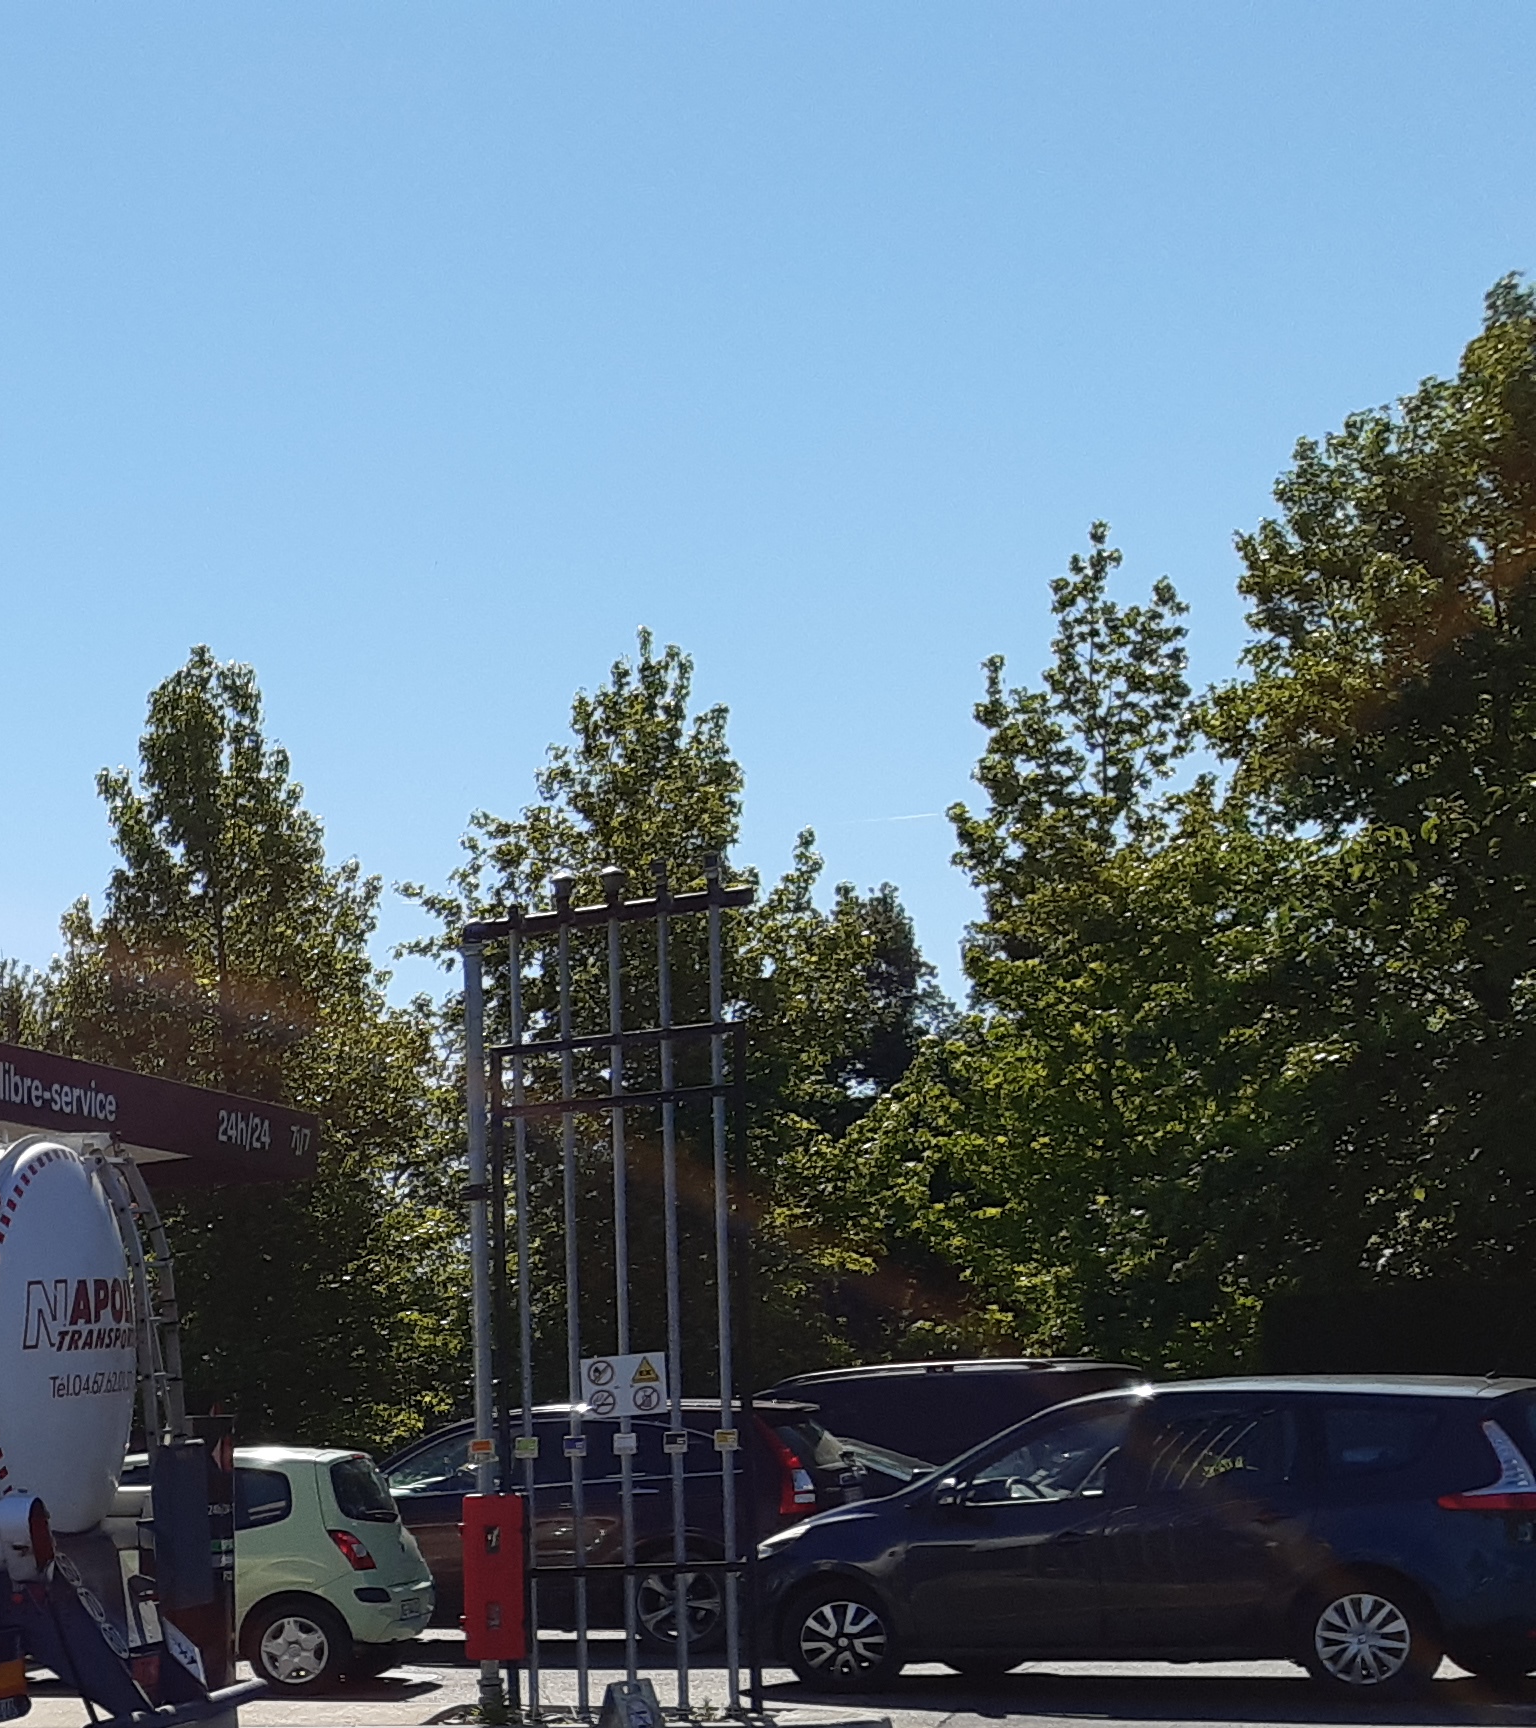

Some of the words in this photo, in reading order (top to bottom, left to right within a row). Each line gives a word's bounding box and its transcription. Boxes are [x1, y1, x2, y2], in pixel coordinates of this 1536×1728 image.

[0, 1061, 116, 1122] libre-service
[218, 1109, 270, 1151] 24h/24
[23, 1278, 133, 1349] NAPOL
